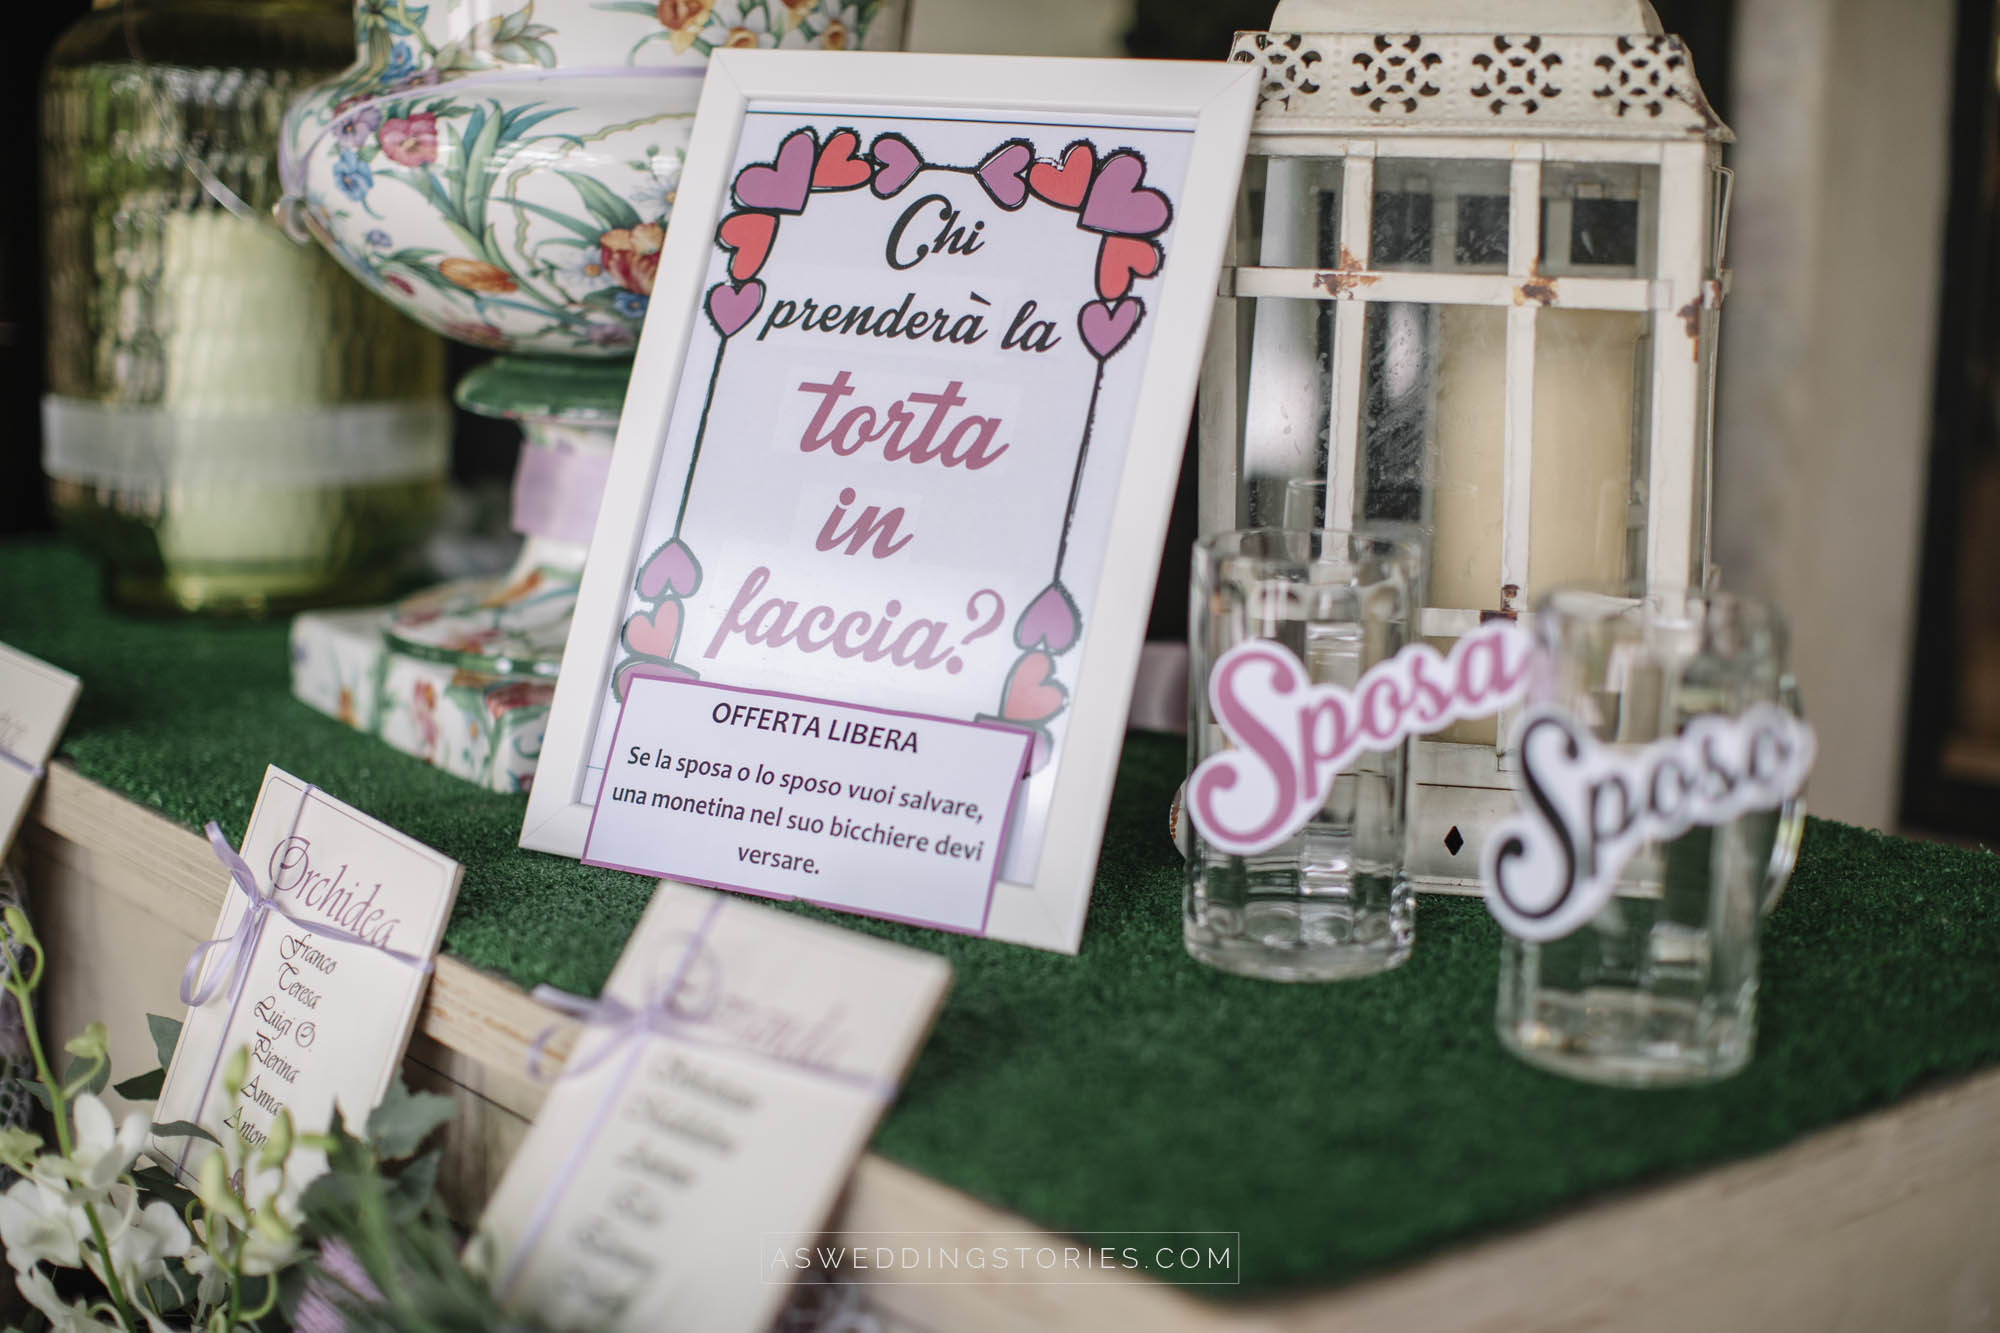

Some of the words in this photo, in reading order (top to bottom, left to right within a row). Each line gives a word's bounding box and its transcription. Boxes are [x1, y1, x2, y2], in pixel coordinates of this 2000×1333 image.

[886, 194, 985, 270] Chi
[757, 292, 991, 344] prenderà
[1001, 301, 1061, 352] la
[798, 370, 1010, 470] torta
[815, 487, 914, 559] in
[703, 566, 1005, 675] faccia?
[712, 702, 820, 738] OFFERTA
[828, 719, 918, 753] LIBERA
[1196, 631, 1530, 844] Sposa
[627, 746, 651, 766] Se
[655, 748, 672, 770] la
[676, 756, 732, 779] sposa
[737, 766, 750, 782] o
[755, 764, 775, 785] lo
[779, 773, 842, 795] sposo
[848, 785, 896, 805] vuoi
[898, 790, 983, 824] salvare,
[1494, 716, 1794, 920] Sposo
[612, 786, 647, 805] una
[651, 792, 745, 821] monetina
[750, 807, 783, 827] nel
[786, 813, 824, 834] suo
[830, 816, 929, 852] bicchiere
[935, 835, 984, 862] devi
[269, 835, 400, 950] Orchidea
[738, 846, 820, 875] versare.
[279, 962, 322, 1009] Teresa
[280, 934, 338, 975] Franco
[254, 995, 295, 1040] Luigi
[251, 1028, 300, 1083] Pierina
[223, 1105, 268, 1149] Anton
[240, 1074, 282, 1116] Anna
